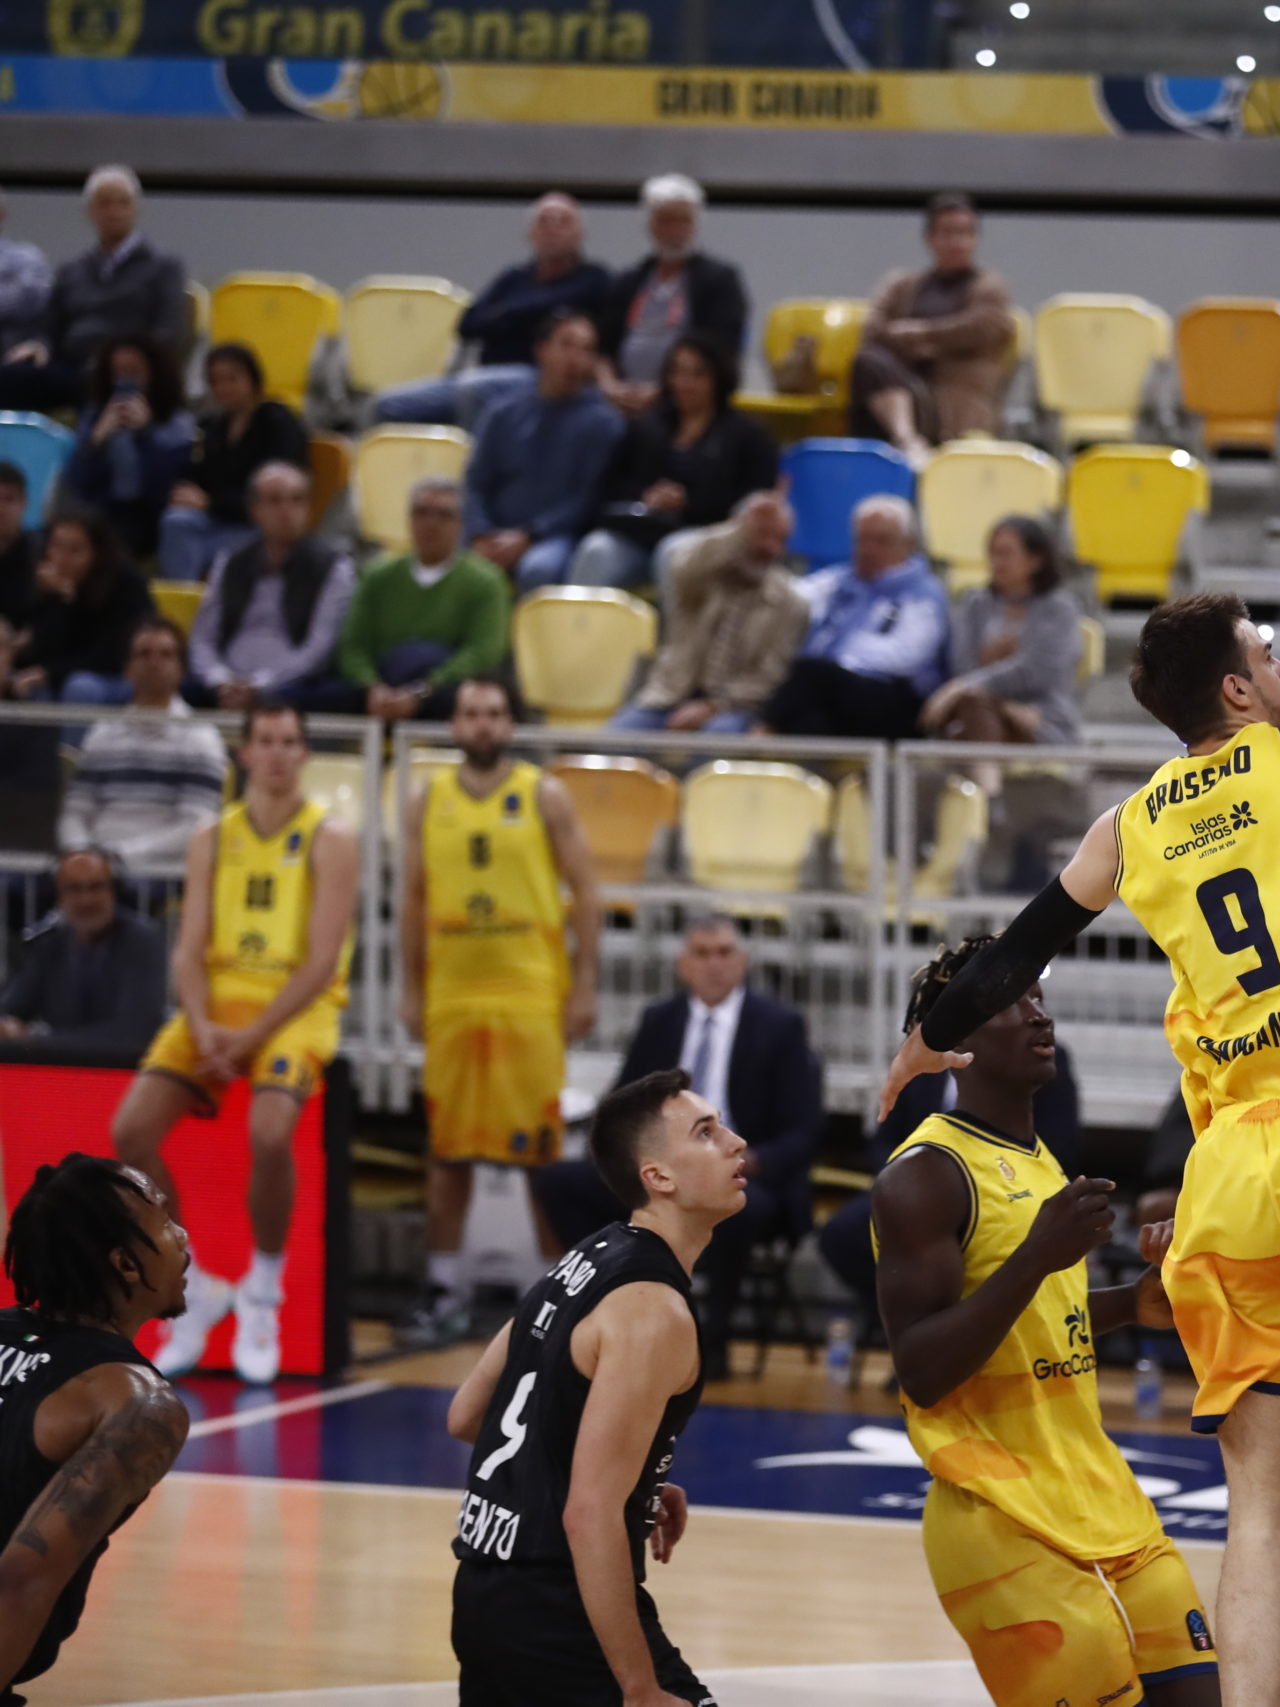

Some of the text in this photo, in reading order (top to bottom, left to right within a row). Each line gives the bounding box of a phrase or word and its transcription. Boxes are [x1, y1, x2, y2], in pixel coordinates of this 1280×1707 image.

[197, 0, 650, 58] Gran Canaria
[657, 77, 881, 121] GRAN CANARIA
[1163, 825, 1232, 861] Canarias
[1190, 813, 1227, 836] Islas
